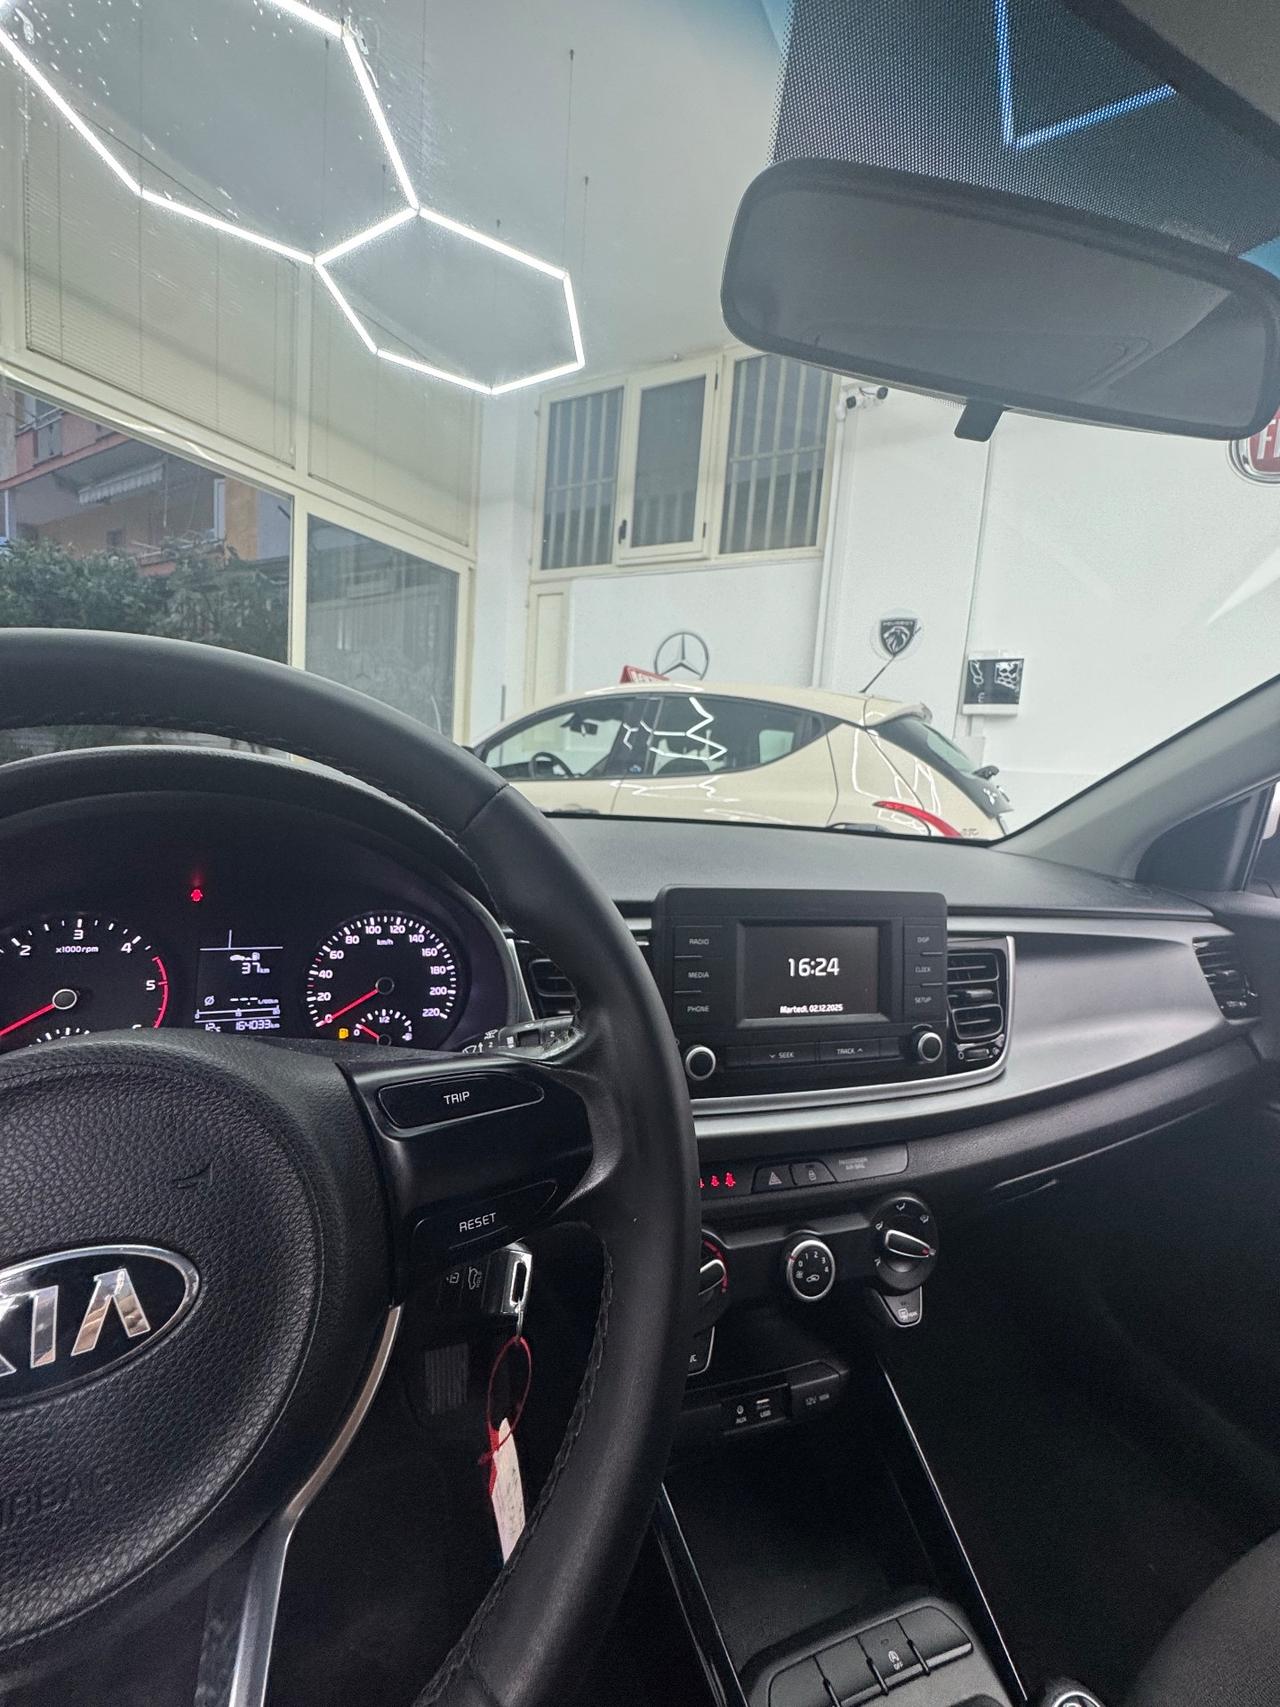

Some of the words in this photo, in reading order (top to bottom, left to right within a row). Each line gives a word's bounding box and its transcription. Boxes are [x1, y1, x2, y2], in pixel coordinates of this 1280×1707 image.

[365, 925, 381, 934] 100
[390, 925, 405, 934] 120
[73, 929, 84, 940] 3
[408, 934, 424, 943] 140
[345, 935, 360, 944] 80
[19, 945, 32, 956] 2
[121, 942, 132, 953] 4
[329, 950, 344, 960] 60
[421, 948, 438, 957] 160
[430, 966, 446, 975] 180
[788, 957, 840, 977] 16:24
[318, 969, 333, 979] 40
[146, 980, 156, 991] 5
[429, 986, 447, 996] 200
[317, 992, 331, 1001] 20
[422, 1008, 440, 1017] 220
[687, 1005, 710, 1013] PHONE
[353, 1028, 360, 1036] 0
[778, 1051, 794, 1059] SEEK
[836, 1047, 855, 1055] TRACK
[443, 1091, 470, 1105] TRIP
[459, 1212, 497, 1233] RESET
[814, 1250, 818, 1258] 2
